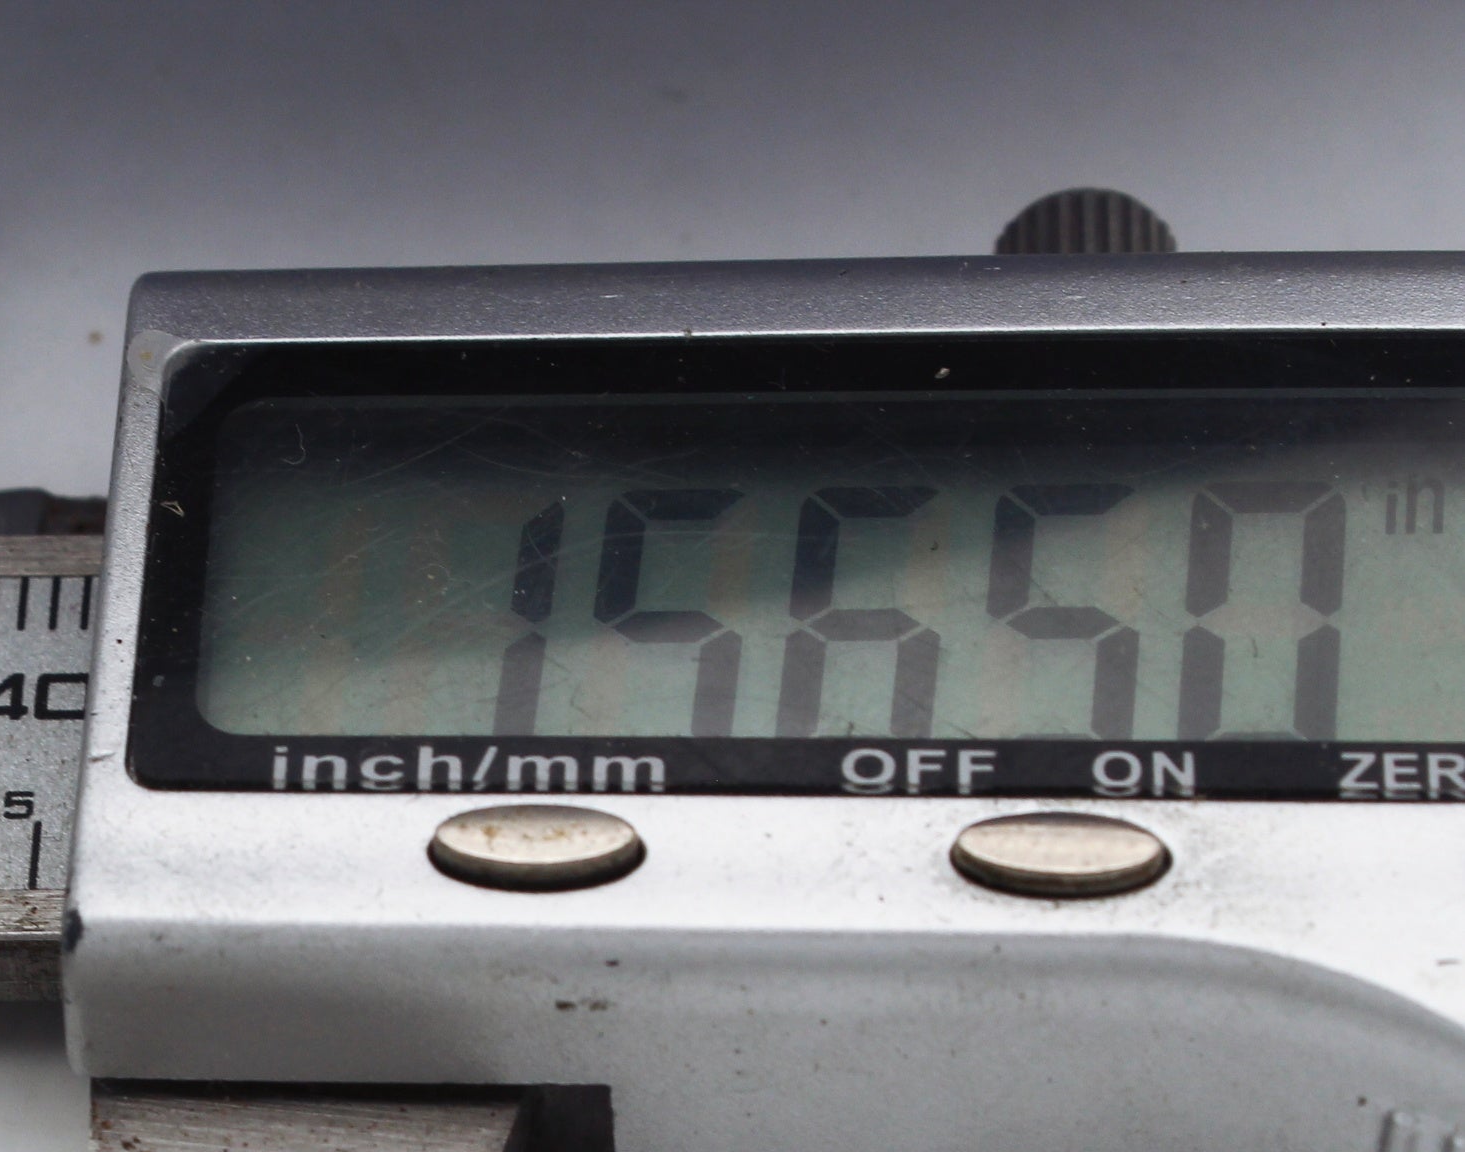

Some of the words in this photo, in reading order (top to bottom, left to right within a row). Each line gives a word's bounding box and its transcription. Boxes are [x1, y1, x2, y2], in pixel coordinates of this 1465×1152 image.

[1384, 476, 1446, 535] in
[272, 745, 666, 791] inch/mm
[841, 747, 997, 792] OFF
[1092, 750, 1196, 792] ON
[2, 790, 36, 821] 5
